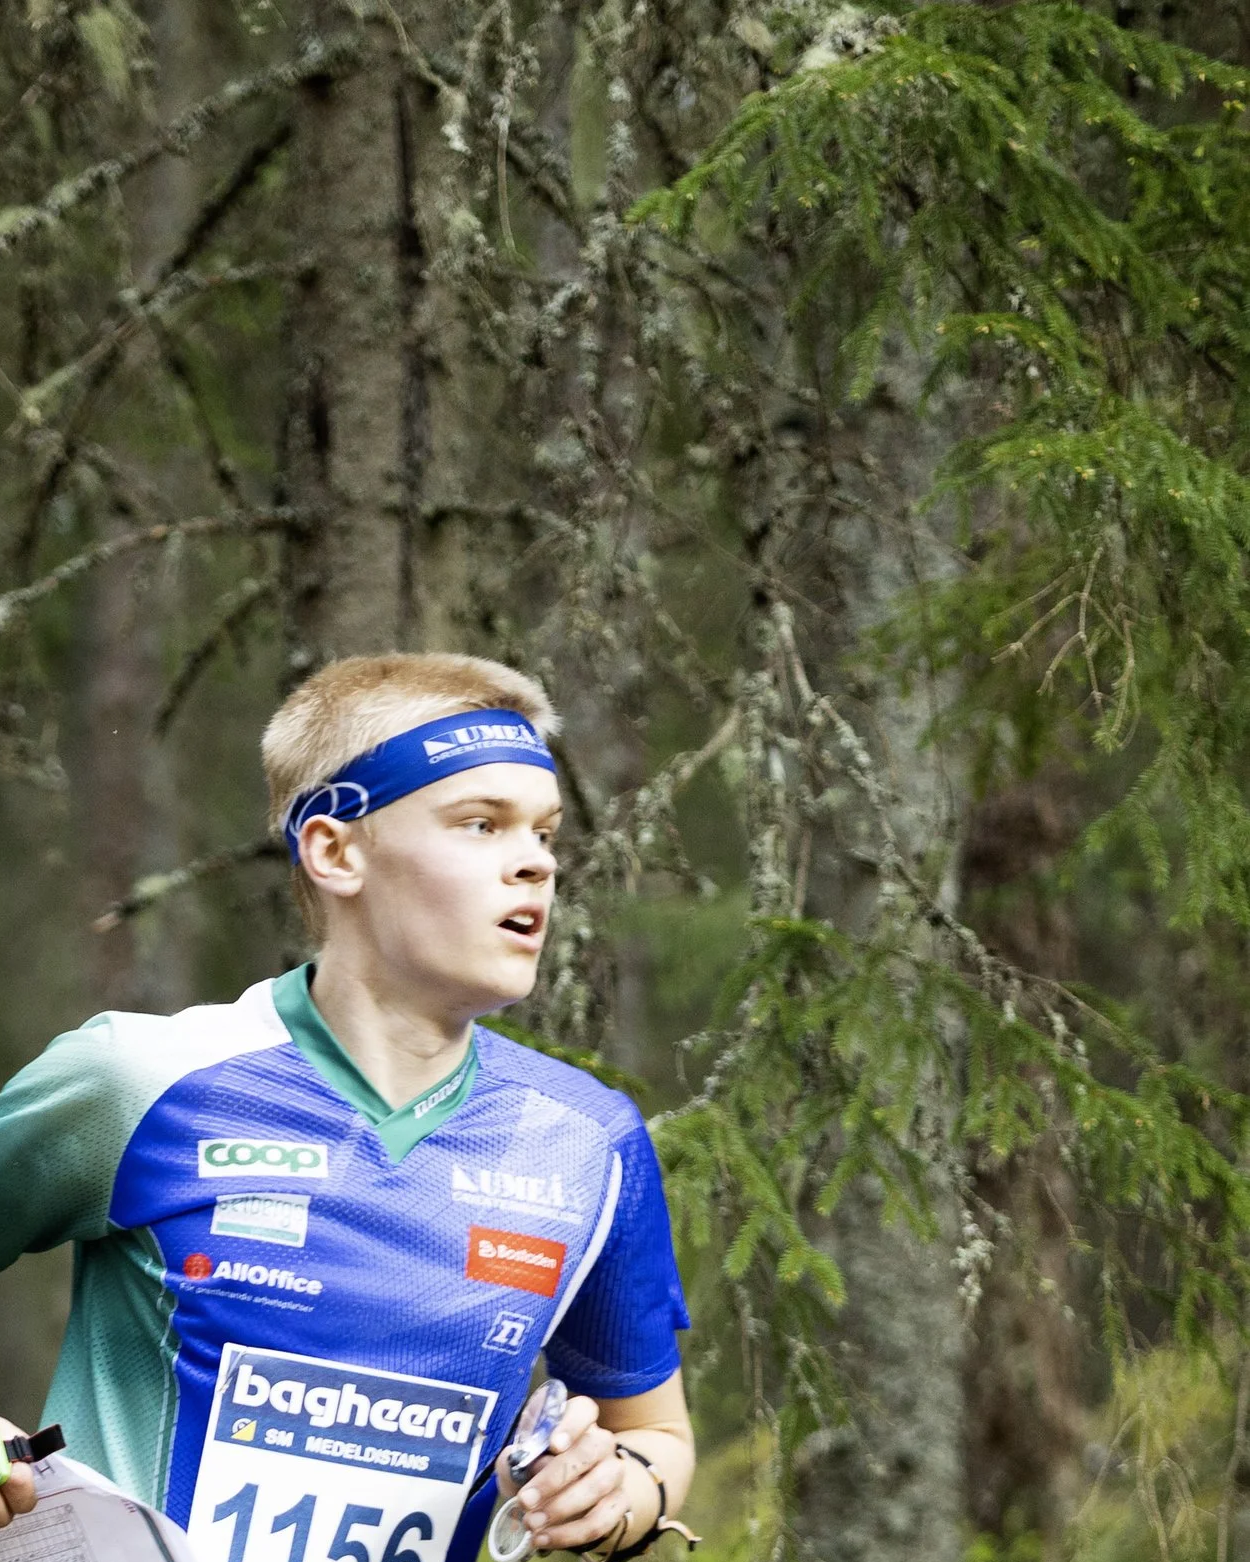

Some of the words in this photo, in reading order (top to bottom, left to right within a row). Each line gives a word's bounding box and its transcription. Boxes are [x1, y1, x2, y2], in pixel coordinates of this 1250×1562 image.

[204, 1143, 321, 1173] coop
[212, 1260, 324, 1296] AllOffice
[232, 1364, 475, 1444] bagheera
[264, 1428, 295, 1447] SM
[305, 1436, 430, 1471] MEDELDISTANS
